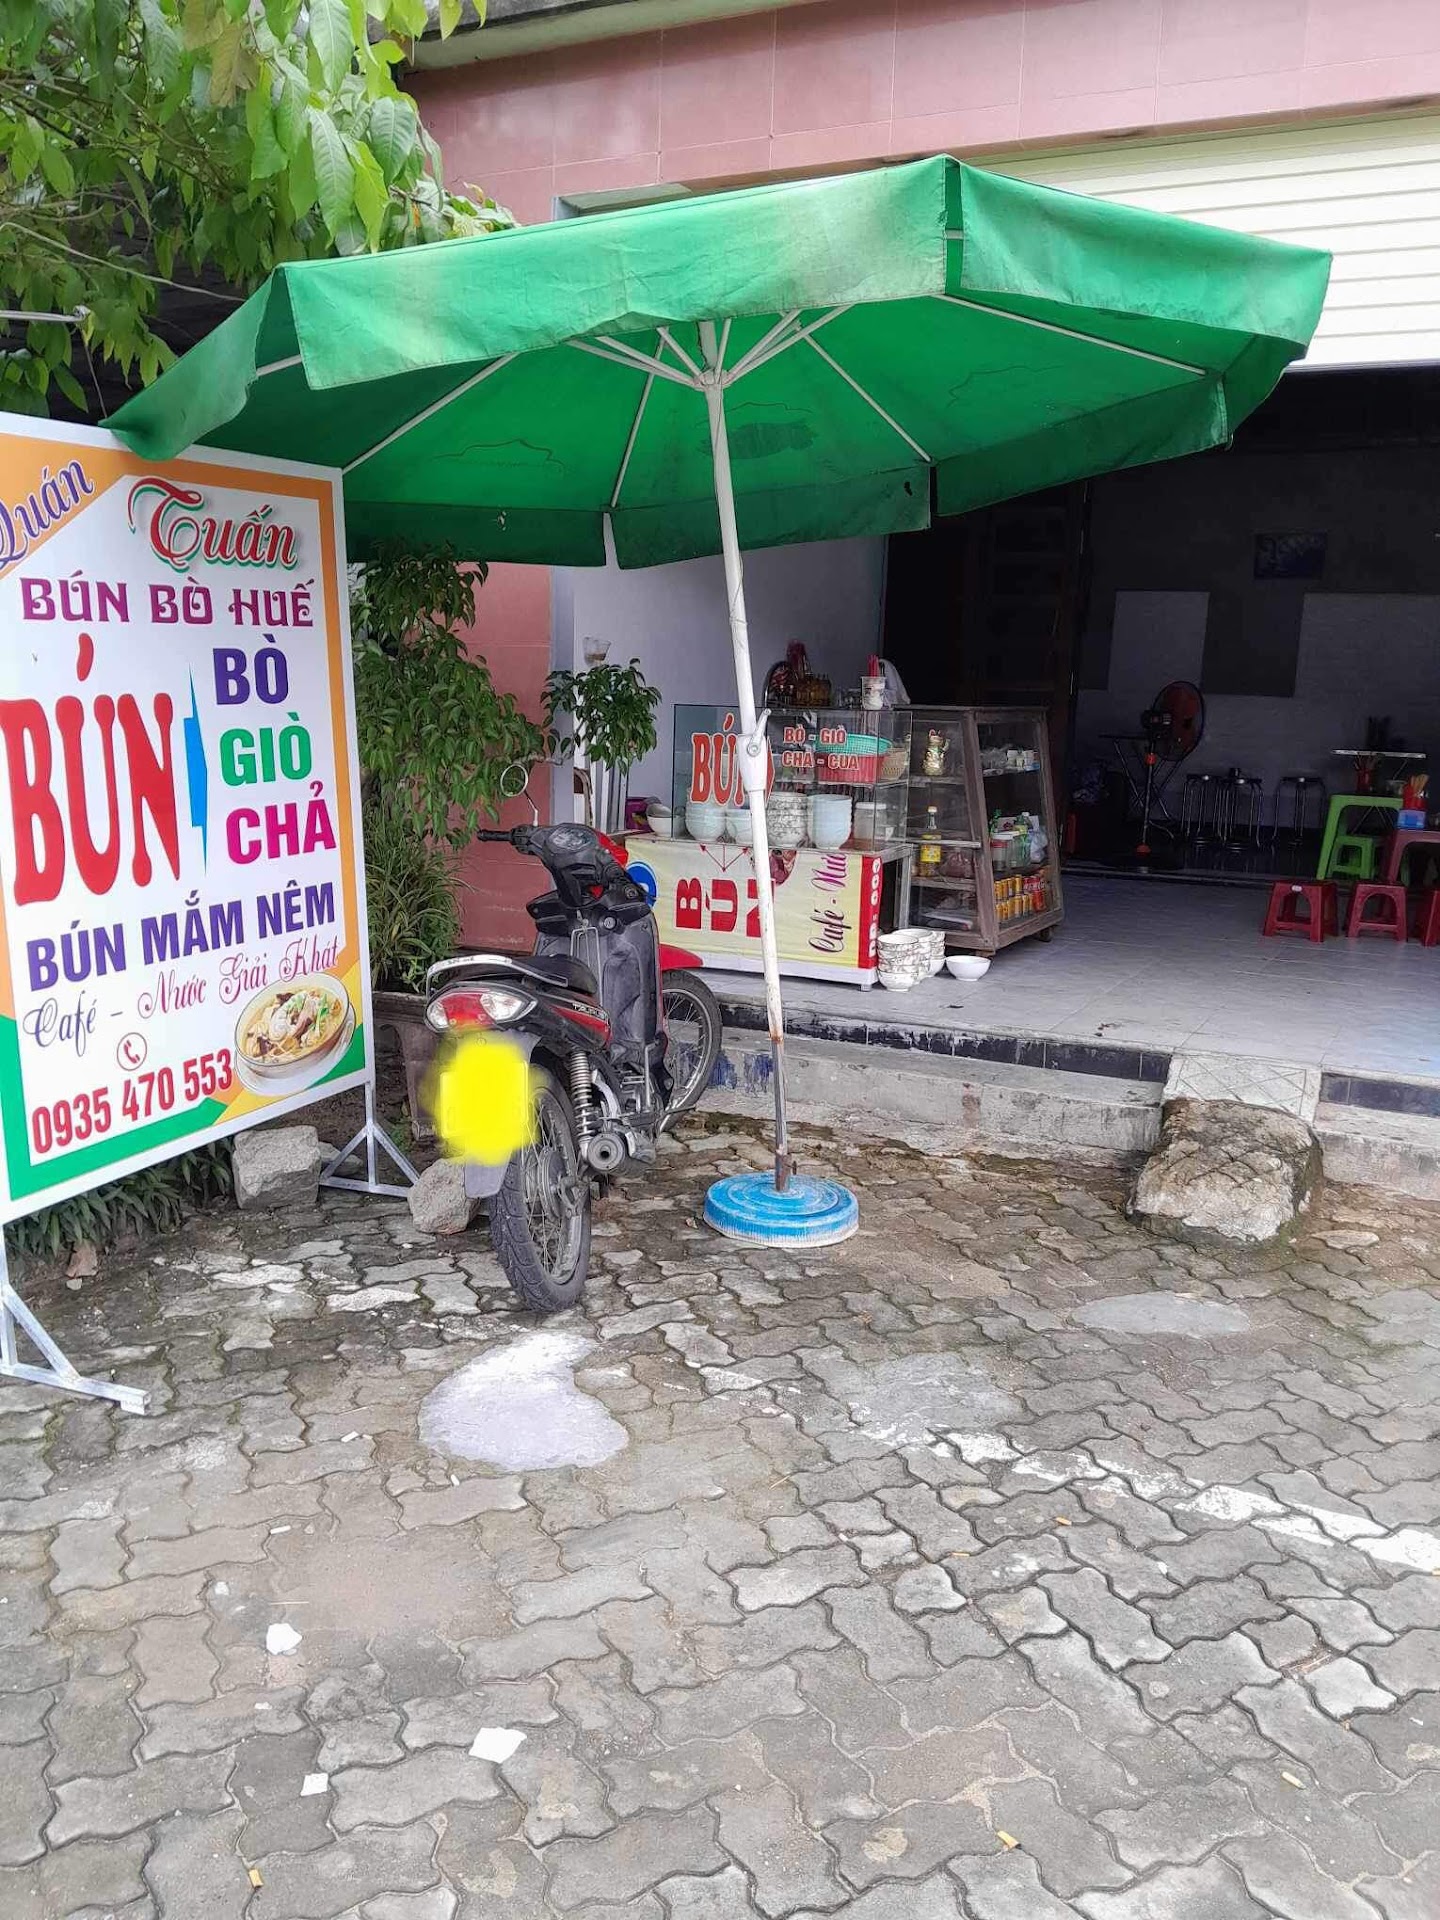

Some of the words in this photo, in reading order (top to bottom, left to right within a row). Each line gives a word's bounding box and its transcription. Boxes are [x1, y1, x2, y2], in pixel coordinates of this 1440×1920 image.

[128, 475, 299, 572] Tuấn
[20, 569, 130, 623] BÚN
[149, 575, 214, 625] BÒ
[228, 578, 315, 628] HUẾ
[212, 633, 289, 706] BÒ
[0, 632, 181, 906] BÚN
[219, 711, 312, 787] GIÒ
[690, 713, 746, 806] BÚ
[827, 753, 859, 770] CUA
[225, 780, 337, 865] CHẢ
[26, 920, 127, 992] BÚN
[140, 889, 246, 966] MẮM
[256, 879, 336, 939] NÊM
[808, 908, 852, 953] Café
[23, 989, 98, 1057] Café
[137, 969, 208, 1020] Nước
[219, 952, 269, 1005] Giải
[278, 934, 340, 983] Khát
[31, 1086, 113, 1155] 0935
[121, 1065, 176, 1123] 470
[183, 1047, 234, 1102] 553
